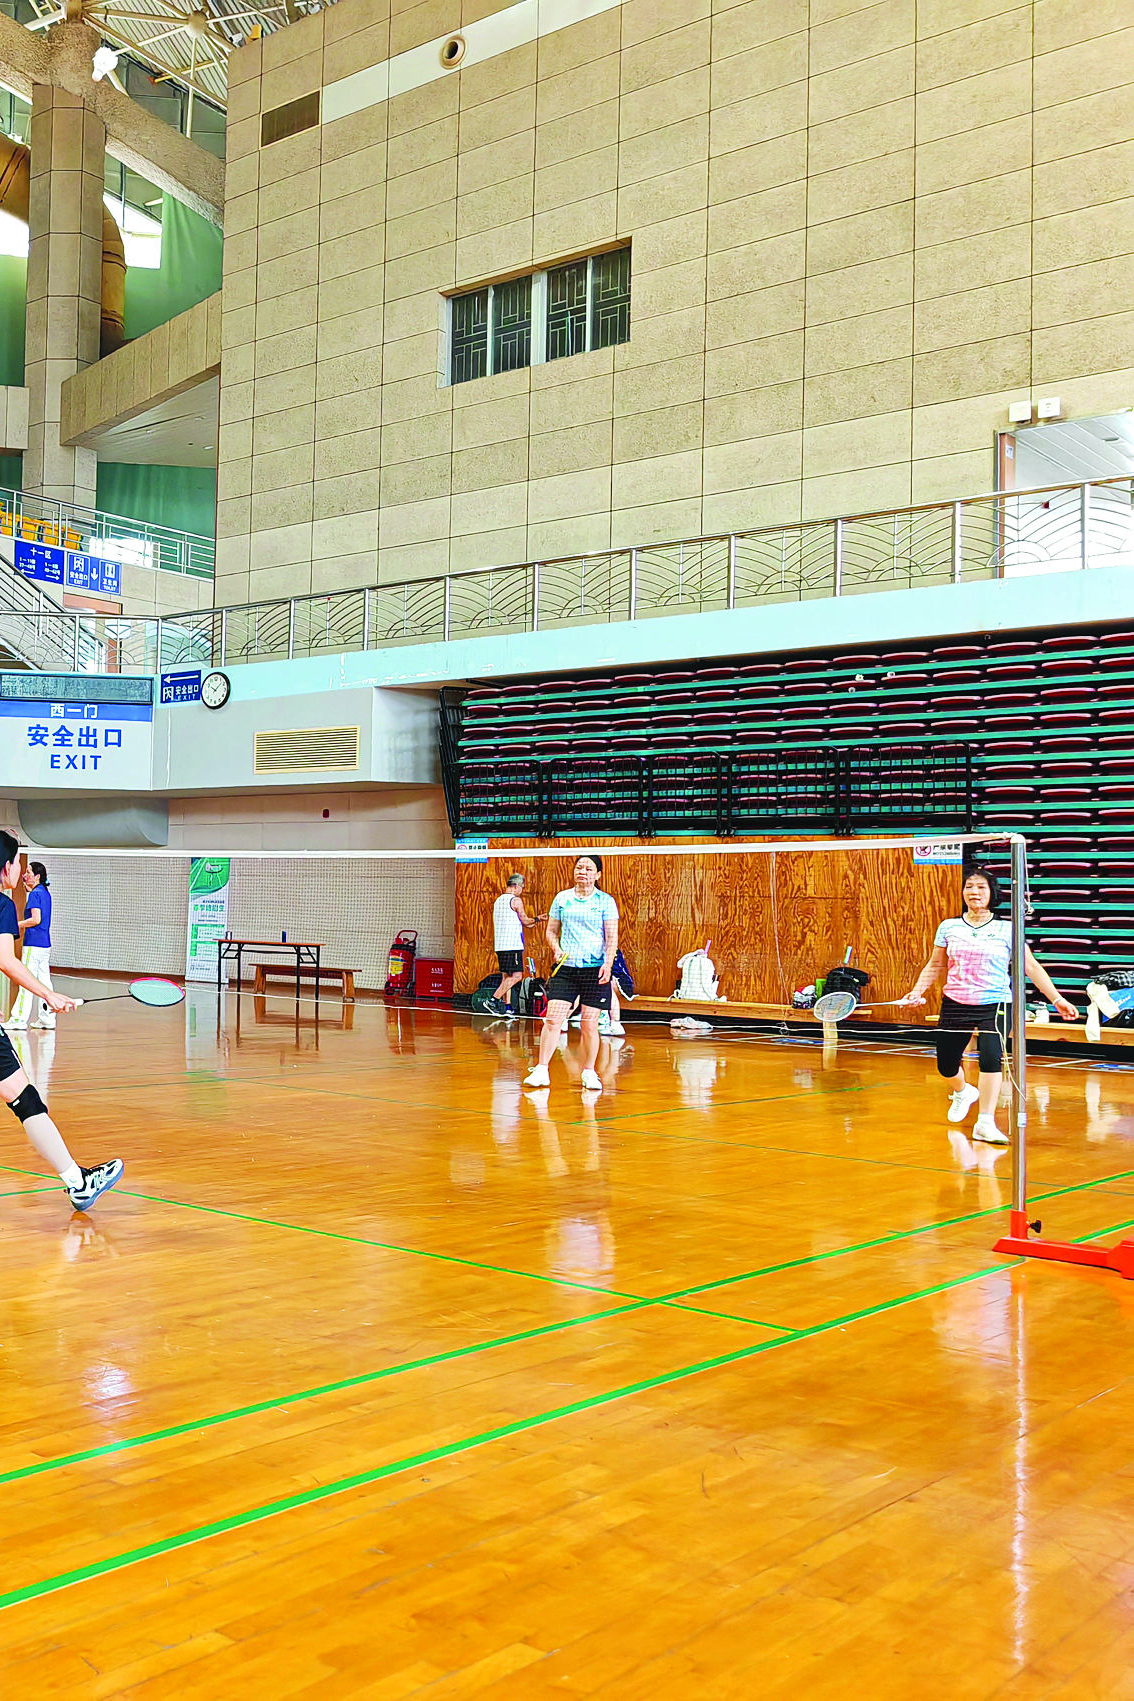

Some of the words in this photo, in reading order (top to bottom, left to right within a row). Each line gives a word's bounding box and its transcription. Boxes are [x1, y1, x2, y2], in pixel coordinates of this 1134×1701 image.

[30, 547, 51, 559] 十一区
[70, 571, 87, 580] 安全出口
[103, 578, 117, 587] 卫生间
[176, 685, 199, 695] 安全出口
[50, 703, 98, 719] 西一门
[27, 724, 122, 748] 安全出口
[50, 754, 102, 770] EXIT
